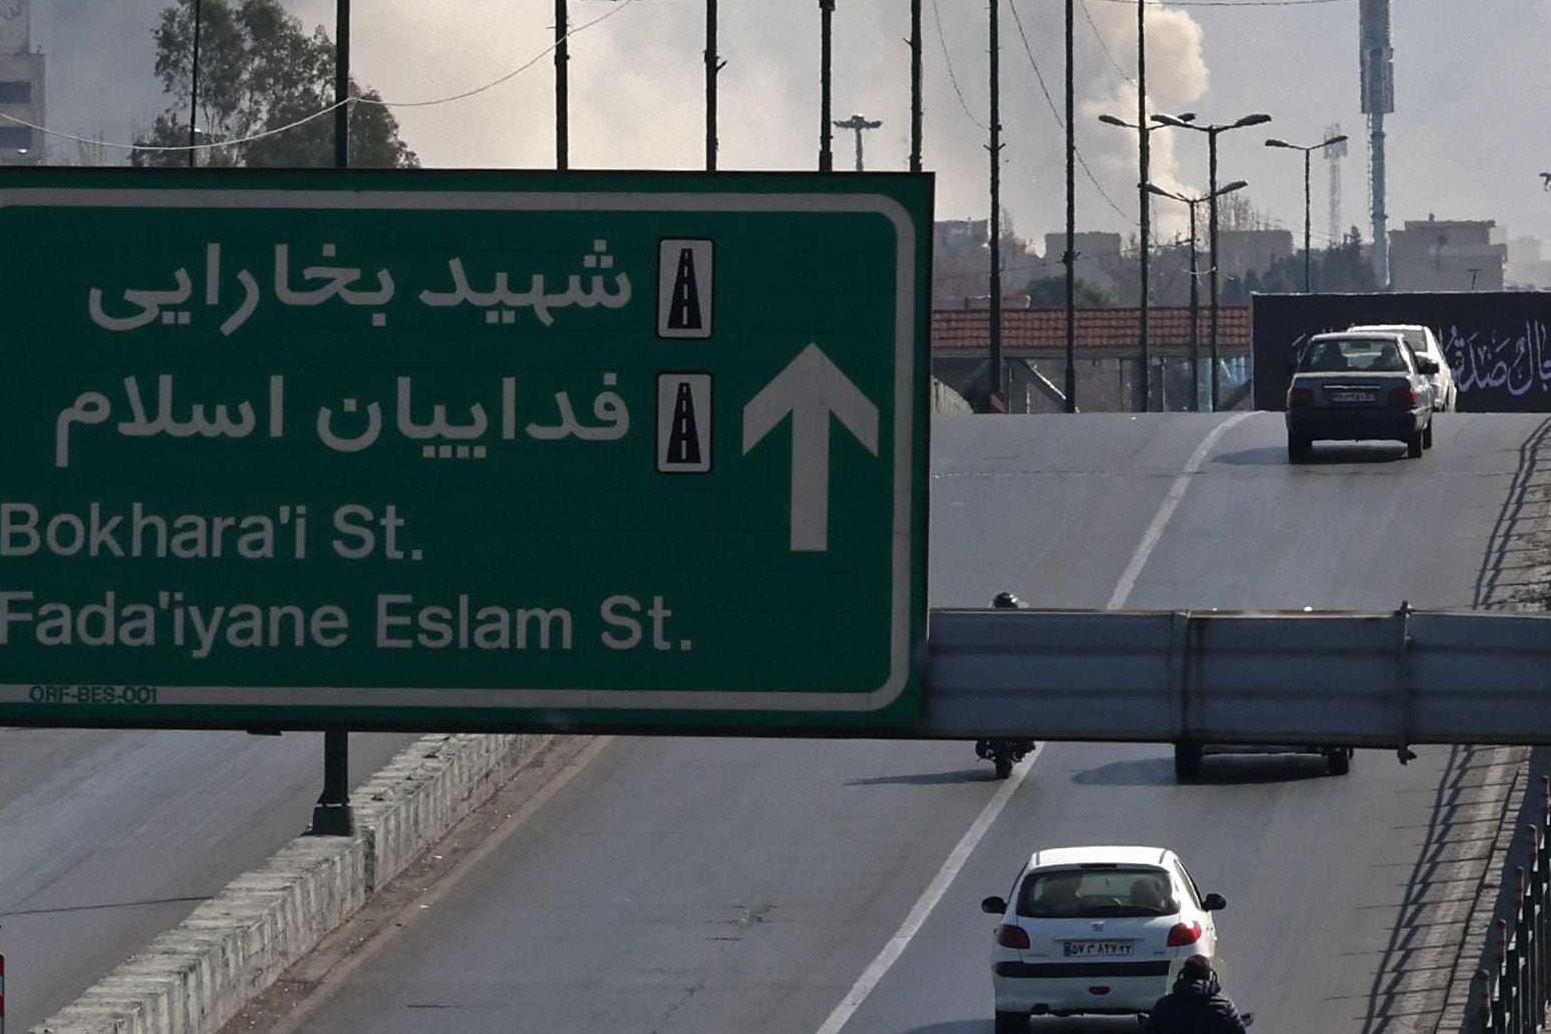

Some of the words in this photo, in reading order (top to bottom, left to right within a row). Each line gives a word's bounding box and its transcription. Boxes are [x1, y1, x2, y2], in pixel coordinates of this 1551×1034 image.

[89, 242, 395, 336] بخارایی
[417, 238, 633, 327] شهید
[55, 373, 285, 467] اسلام
[316, 371, 631, 458] فداییان
[0, 501, 307, 559] Bokhara'i
[331, 503, 424, 561] St.
[375, 593, 573, 650] Eslam
[599, 594, 692, 652] St.
